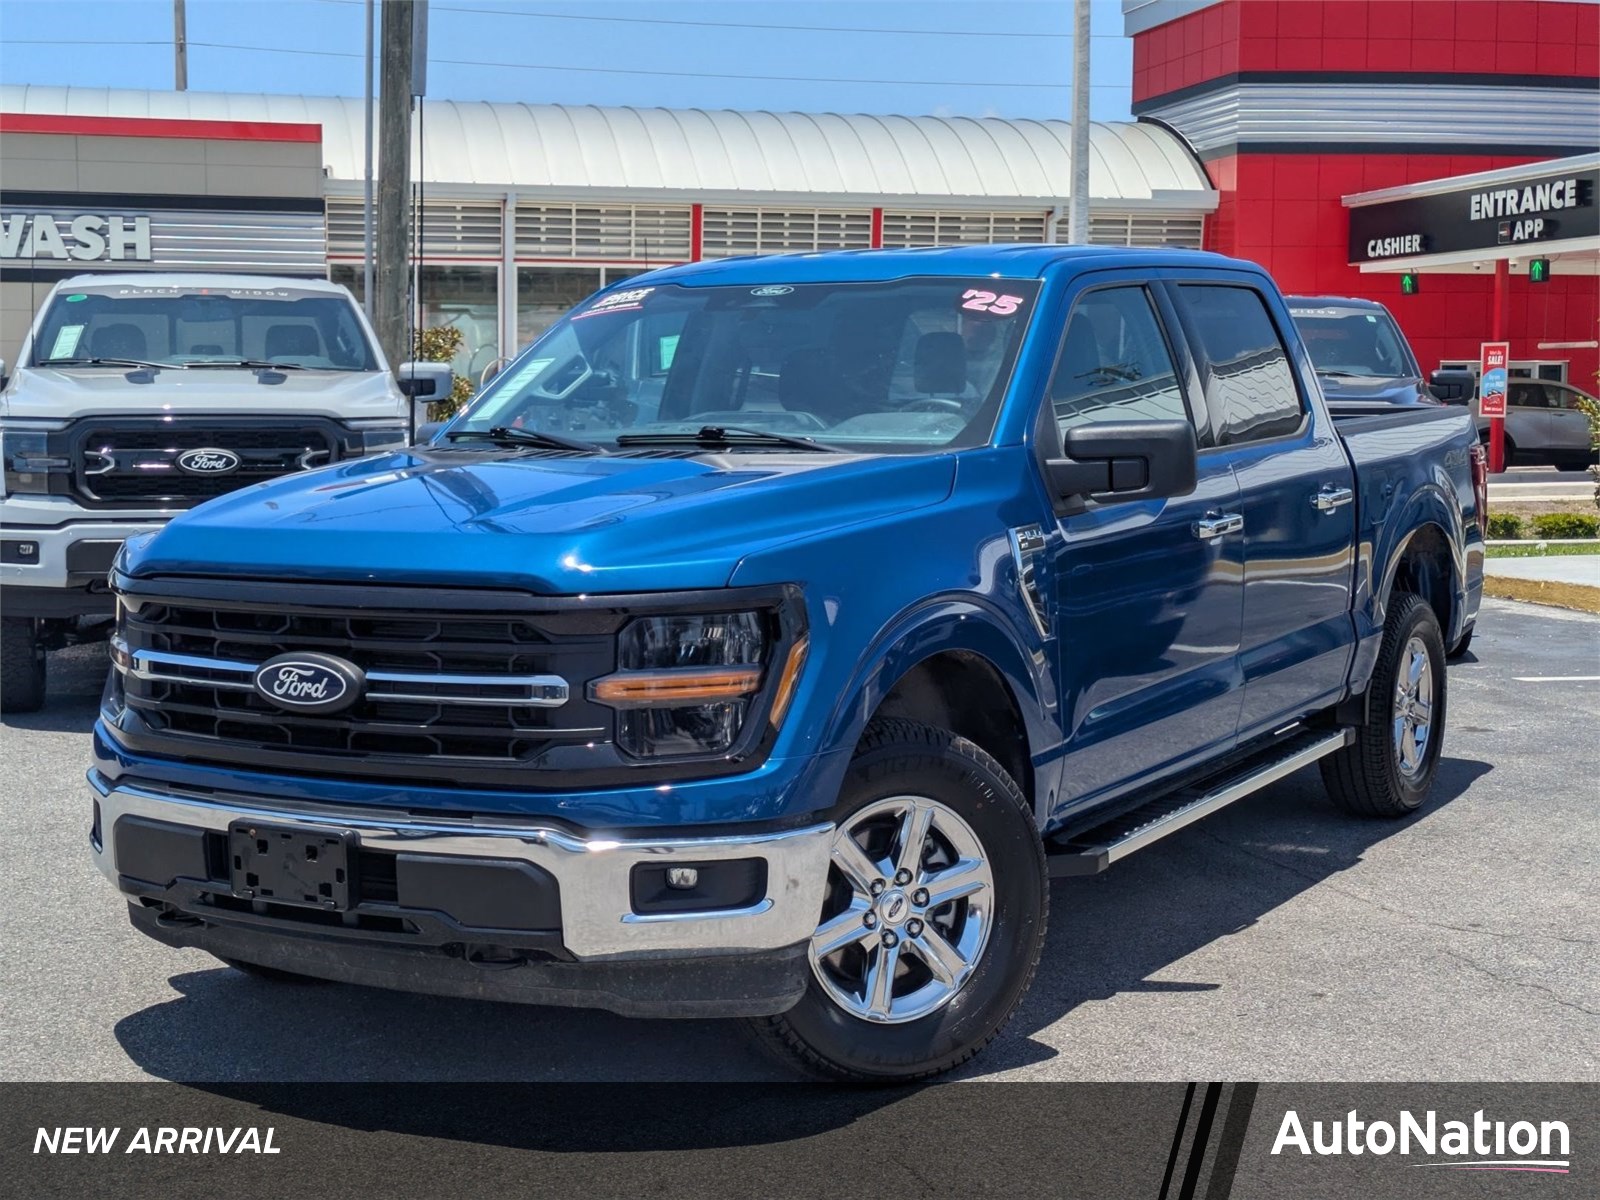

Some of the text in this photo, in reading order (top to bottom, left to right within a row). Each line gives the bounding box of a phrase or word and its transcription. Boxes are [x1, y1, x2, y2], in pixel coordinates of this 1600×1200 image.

[1470, 179, 1576, 220] ENTRANCE
[1513, 219, 1544, 241] APP
[1367, 234, 1421, 257] CASHIER
[231, 289, 288, 297] WIDOW
[962, 289, 1023, 315] '25
[191, 454, 227, 469] Ford
[273, 667, 328, 698] Ford
